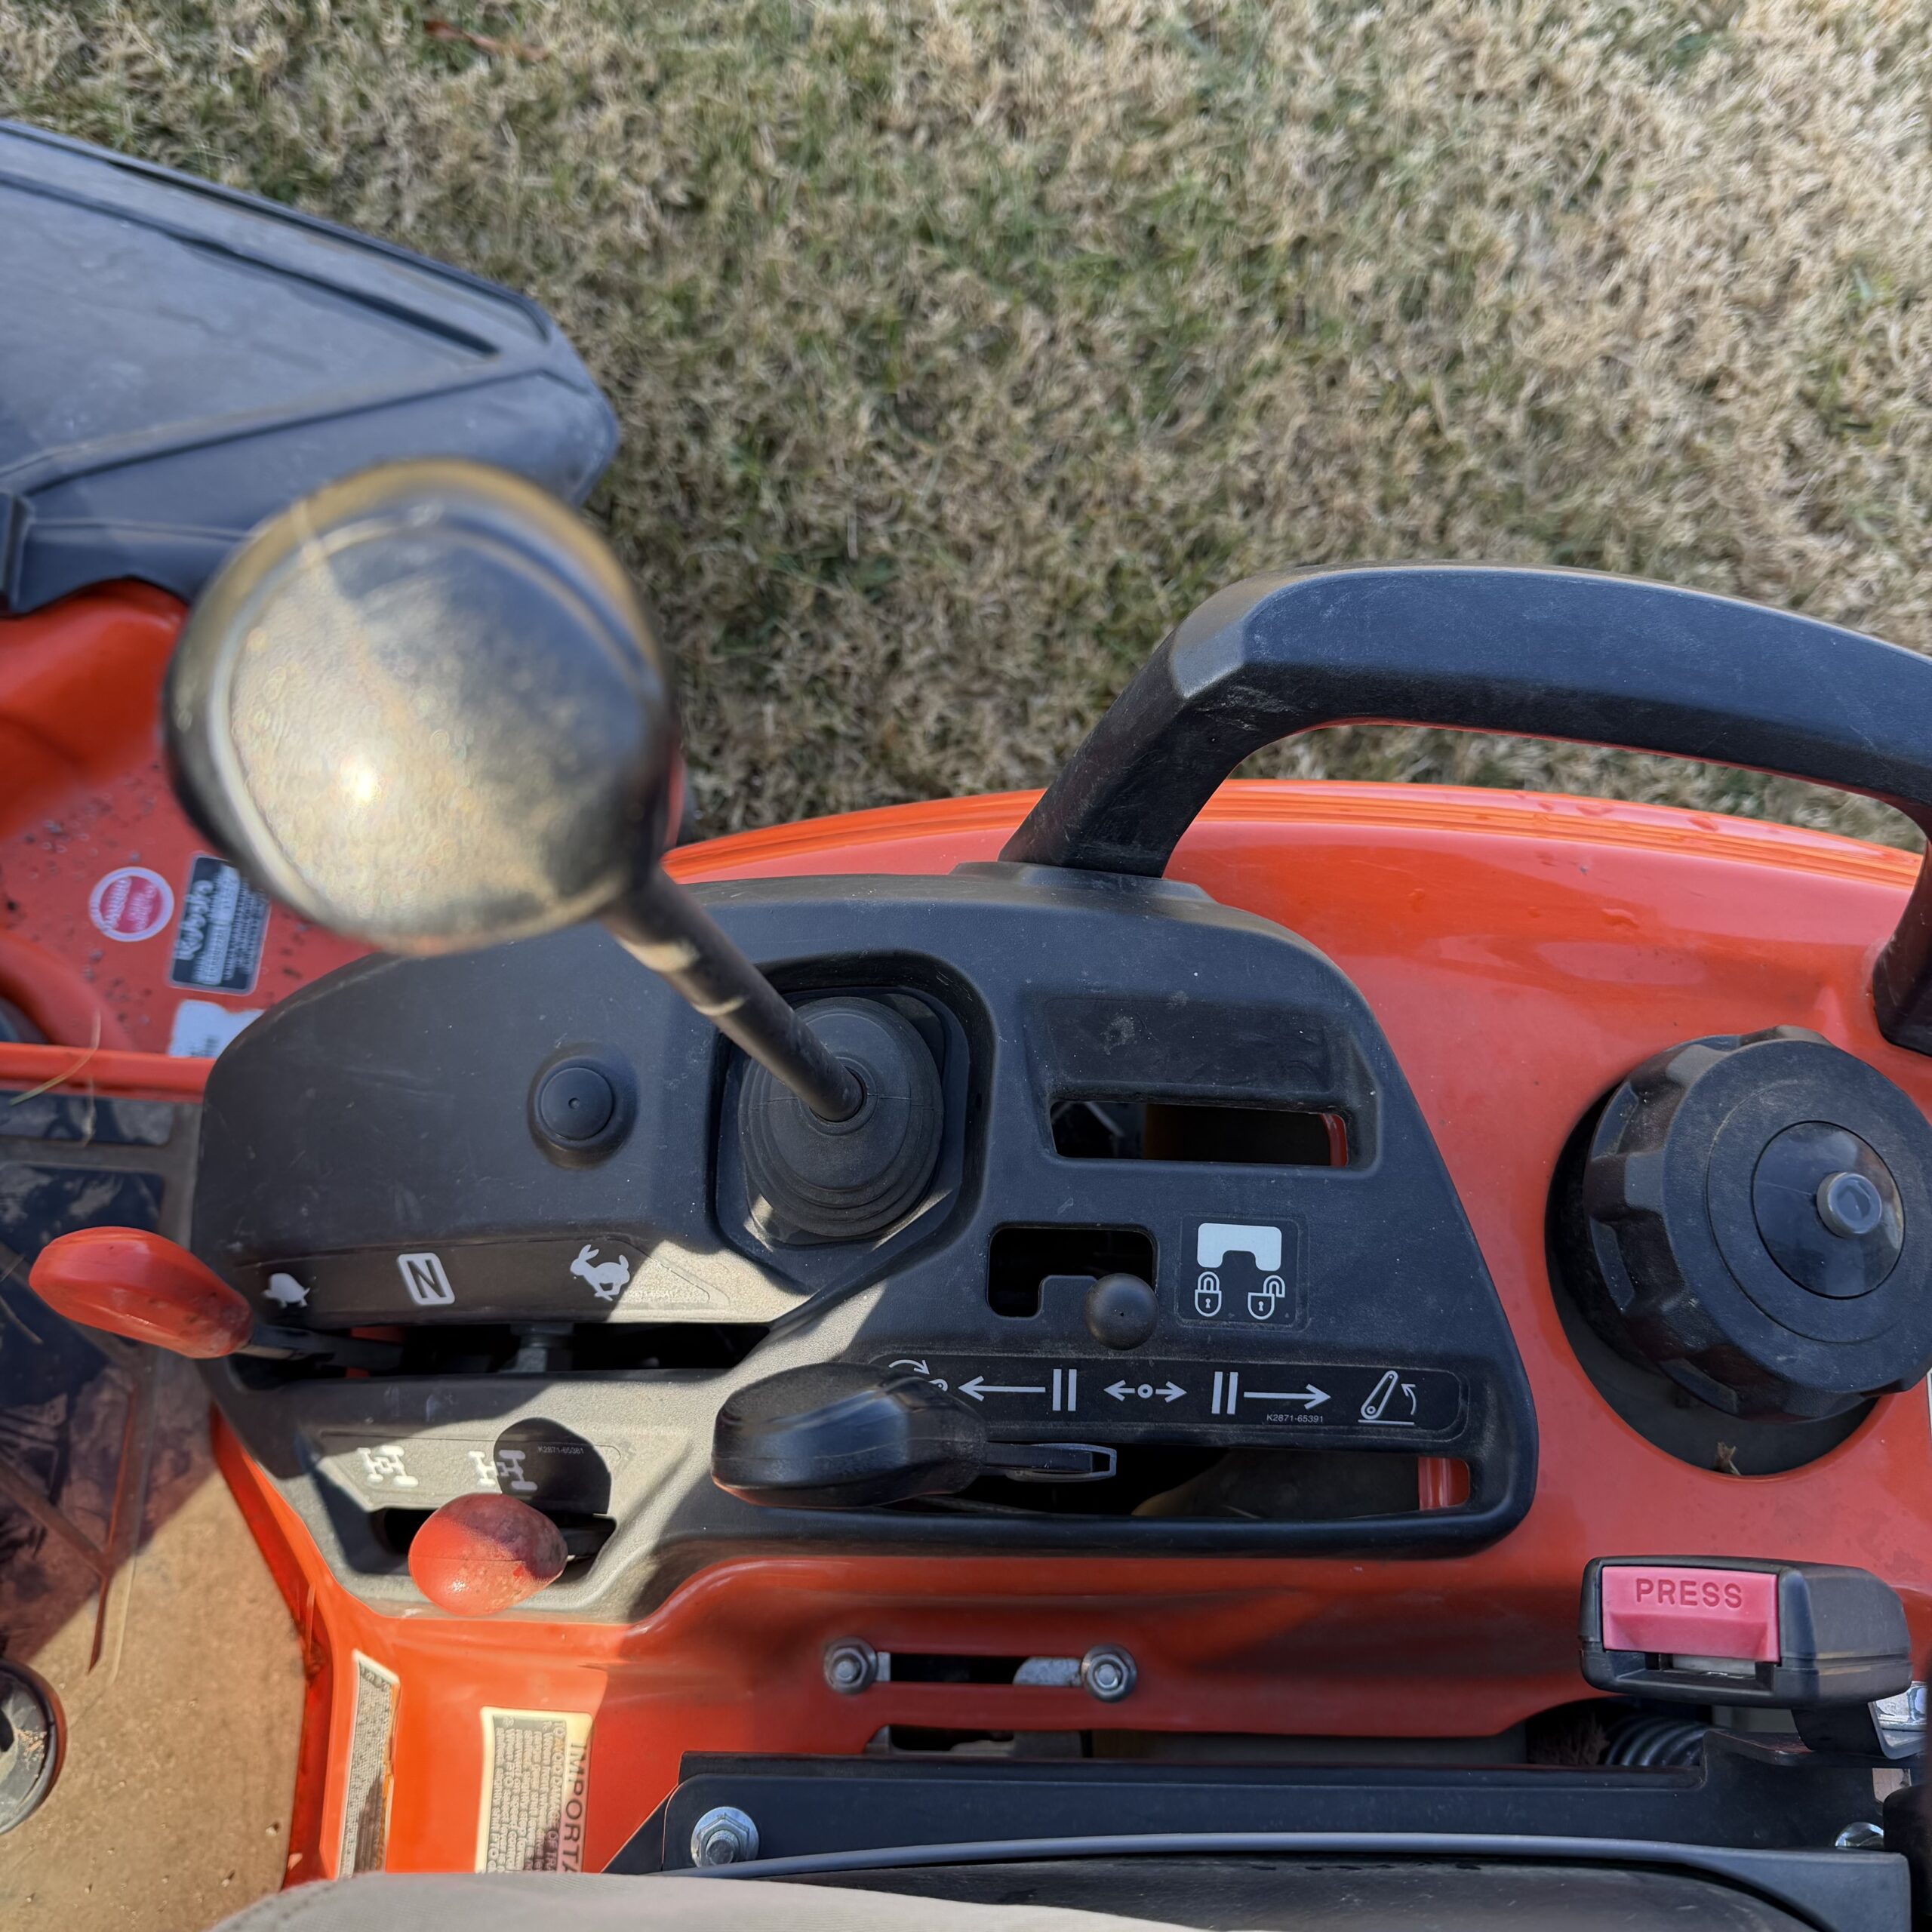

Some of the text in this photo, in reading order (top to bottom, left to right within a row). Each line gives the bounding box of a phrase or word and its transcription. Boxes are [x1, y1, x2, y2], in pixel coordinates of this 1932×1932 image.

[405, 1259, 448, 1299] N
[1266, 1414, 1323, 1423] K2871-65391
[1635, 1578, 1743, 1608] PRESS
